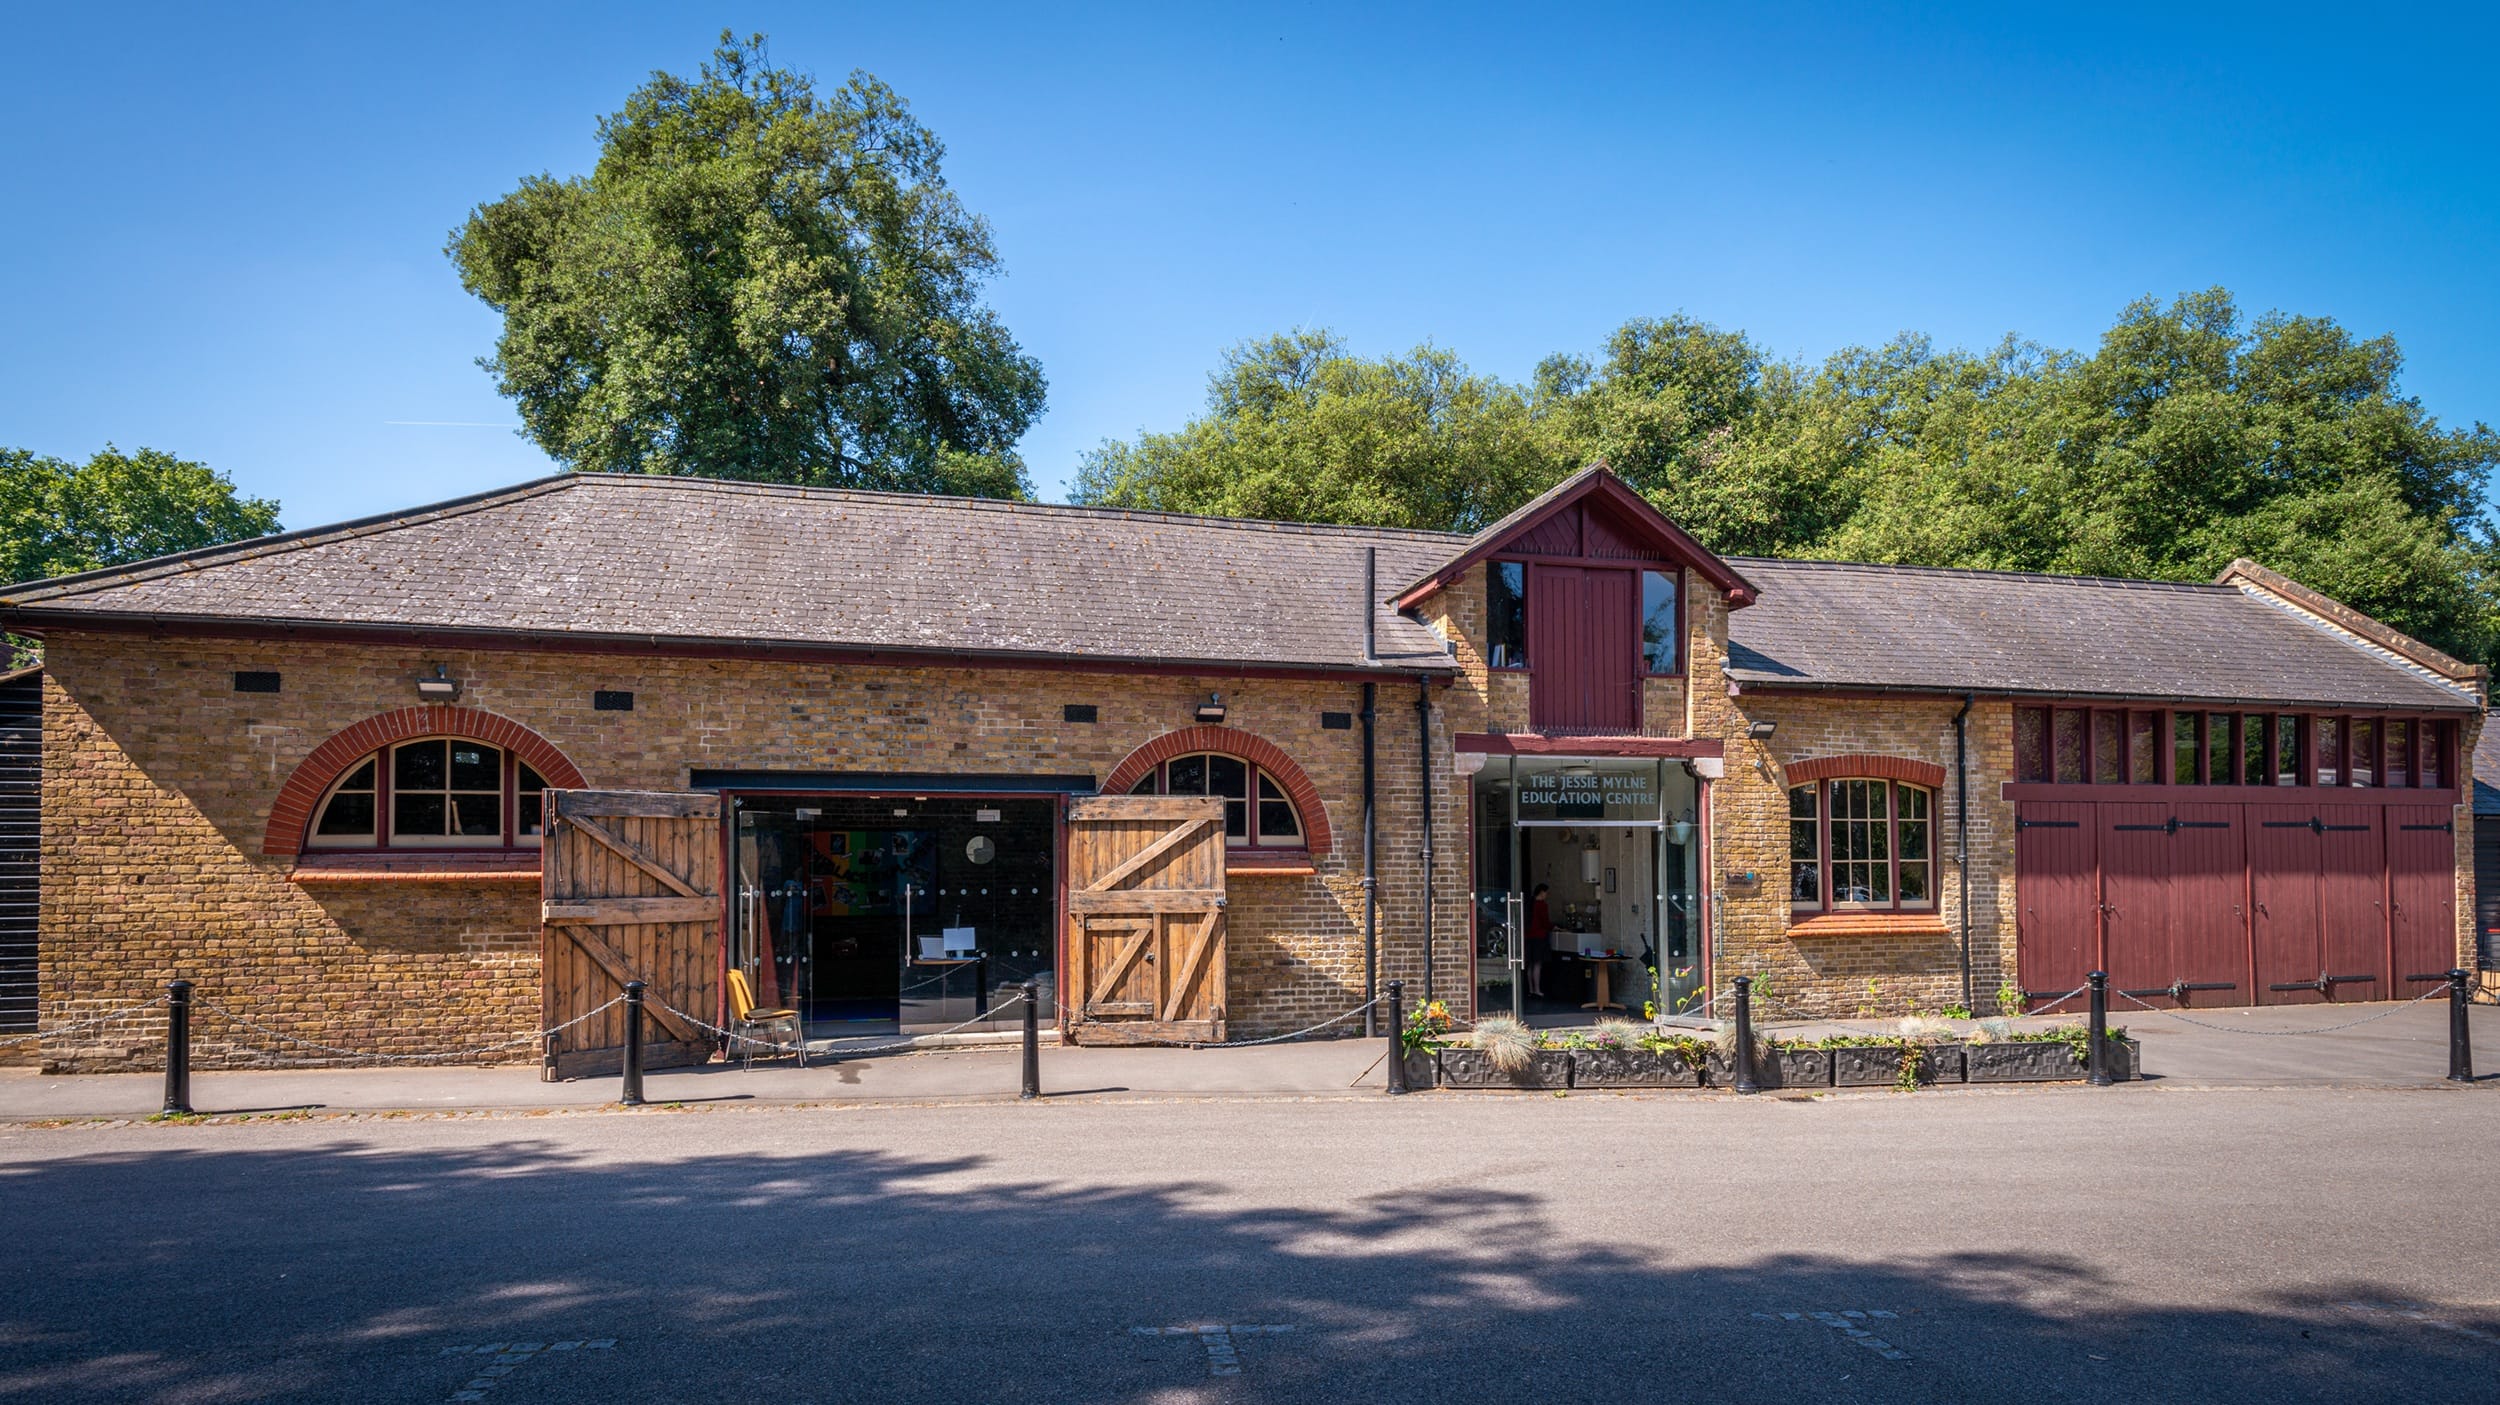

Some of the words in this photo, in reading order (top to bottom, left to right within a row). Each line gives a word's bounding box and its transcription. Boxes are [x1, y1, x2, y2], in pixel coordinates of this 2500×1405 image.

[1530, 775, 1556, 788] THE
[1560, 775, 1598, 790] JESSIE
[1603, 776, 1647, 789] MYLNE
[1521, 791, 1601, 804] EDUCATION
[1606, 792, 1656, 805] CENTRE
